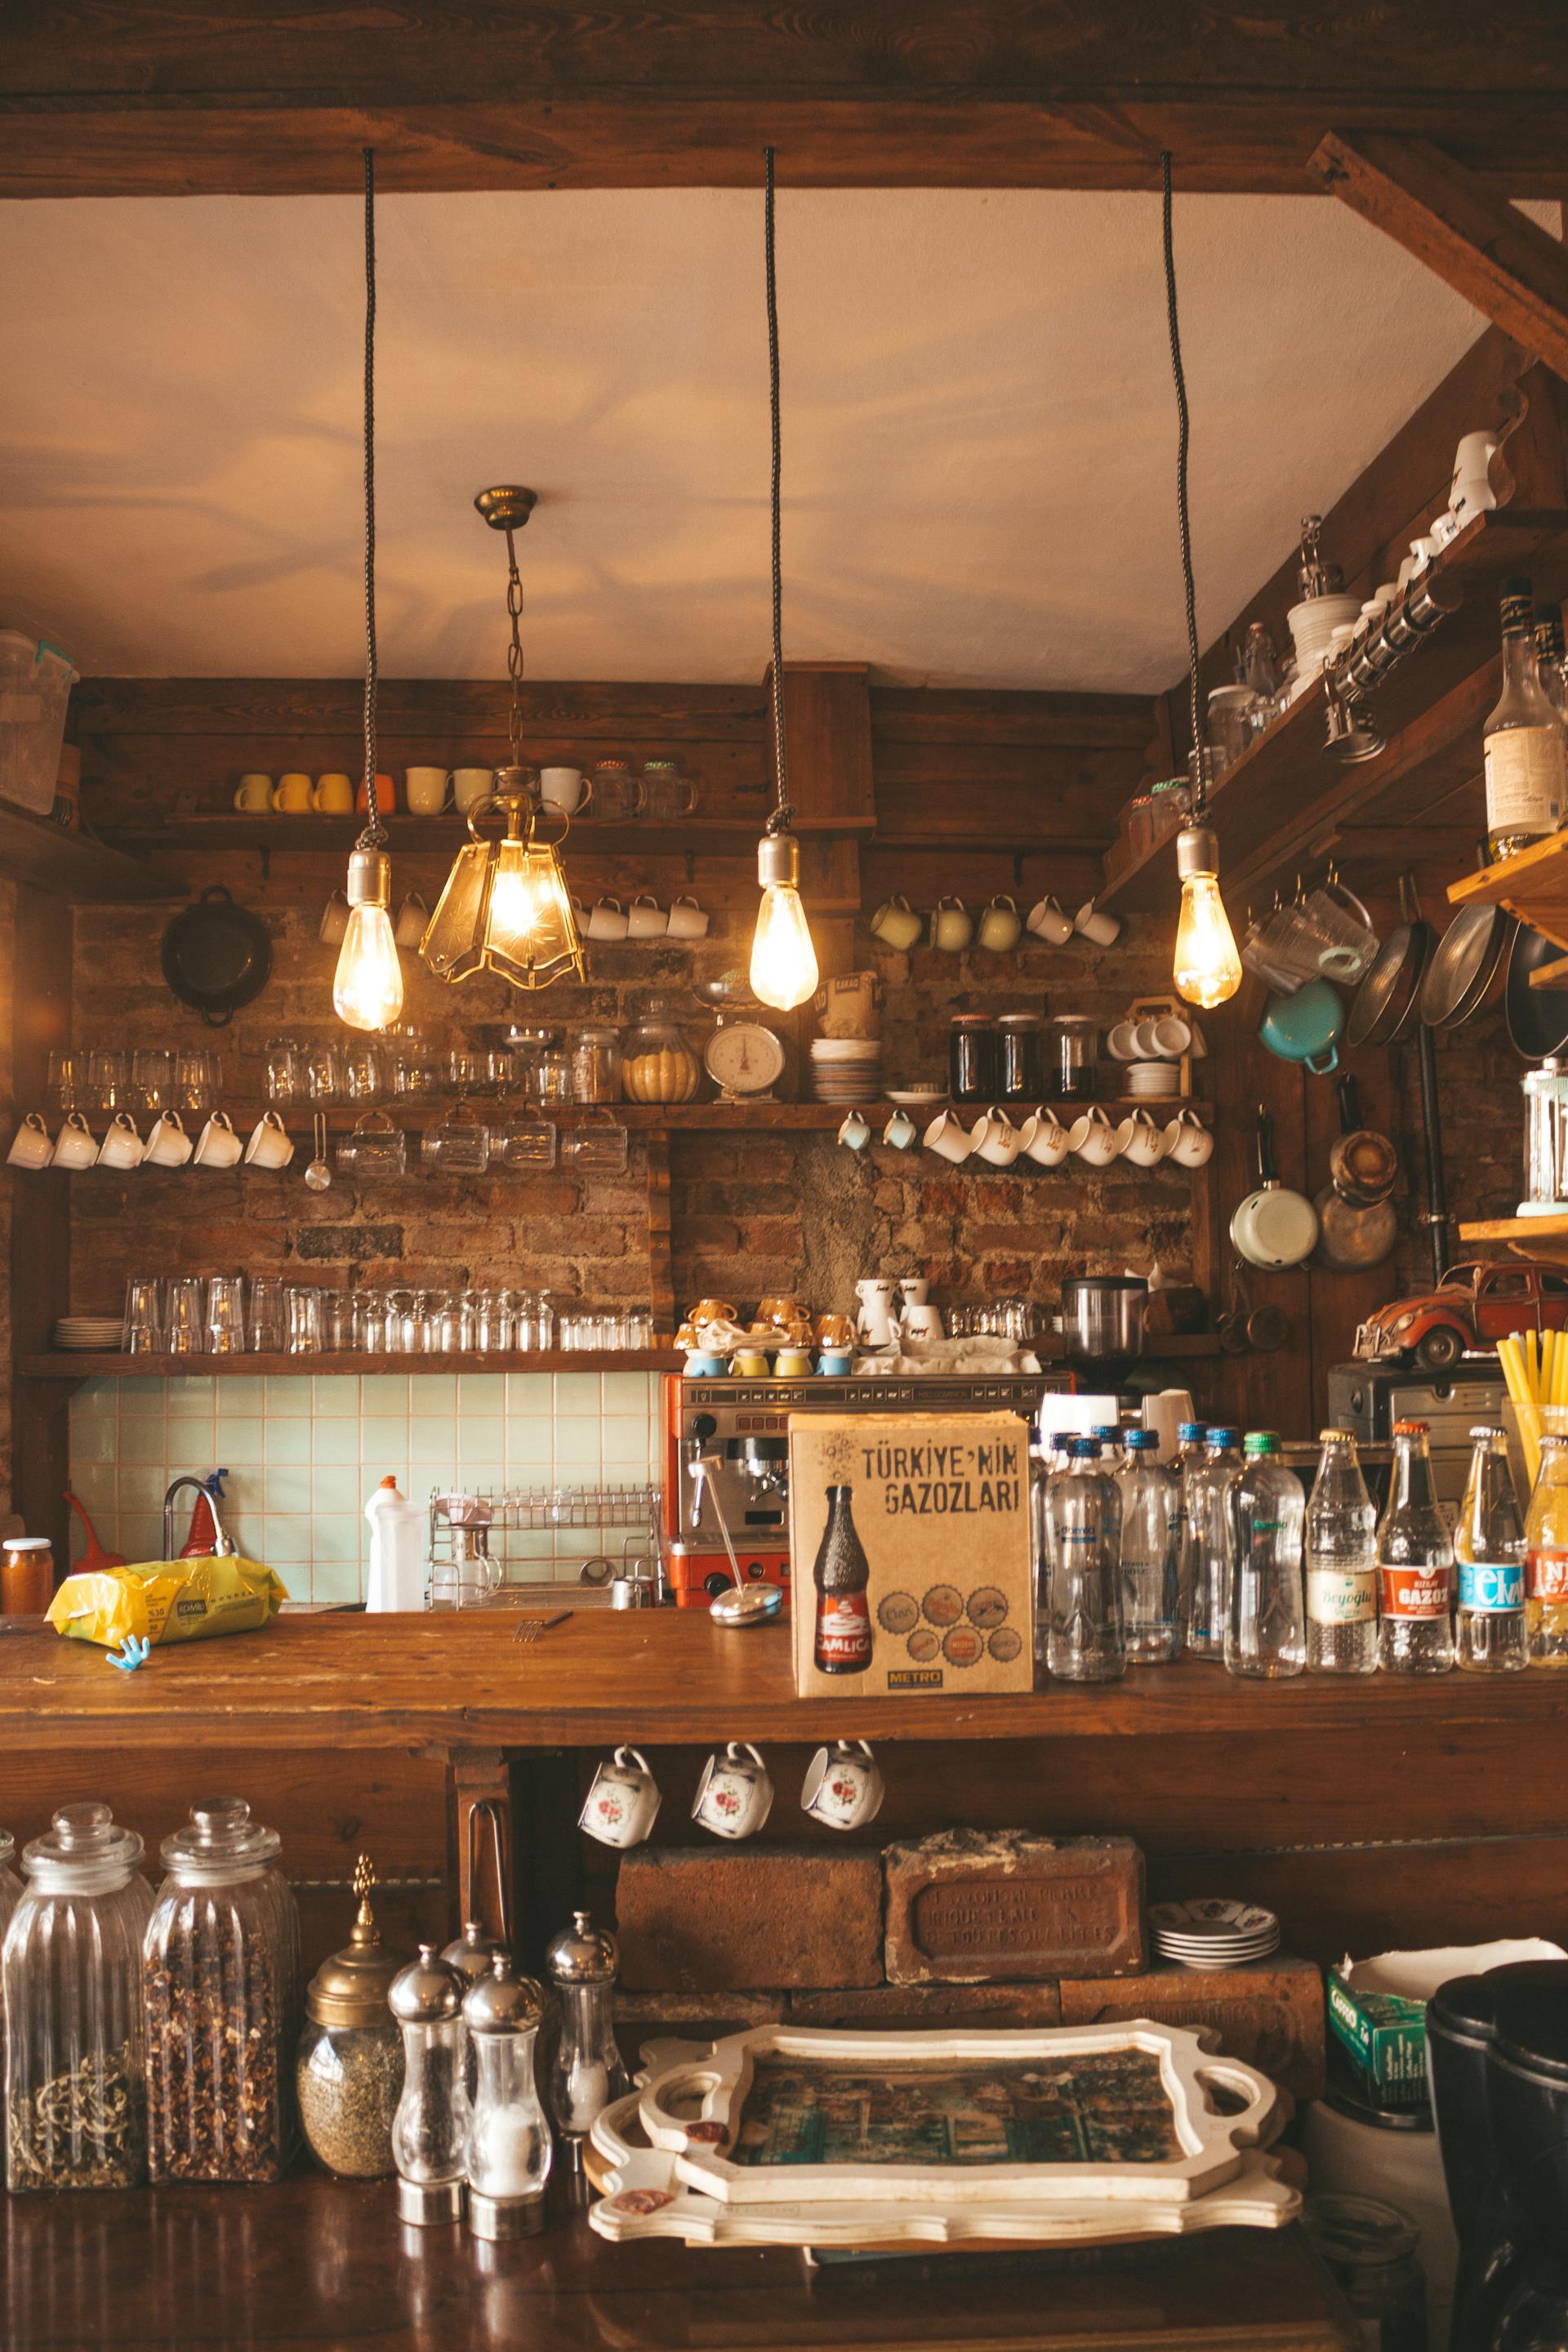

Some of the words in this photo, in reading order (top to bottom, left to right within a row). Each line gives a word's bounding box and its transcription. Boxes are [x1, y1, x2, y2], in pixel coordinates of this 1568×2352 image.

[836, 978, 859, 991] KAKAO
[884, 1480, 1020, 1515] GAZOZLARI
[1398, 1587, 1449, 1606] GAZOZ
[890, 1670, 942, 1684] METRO
